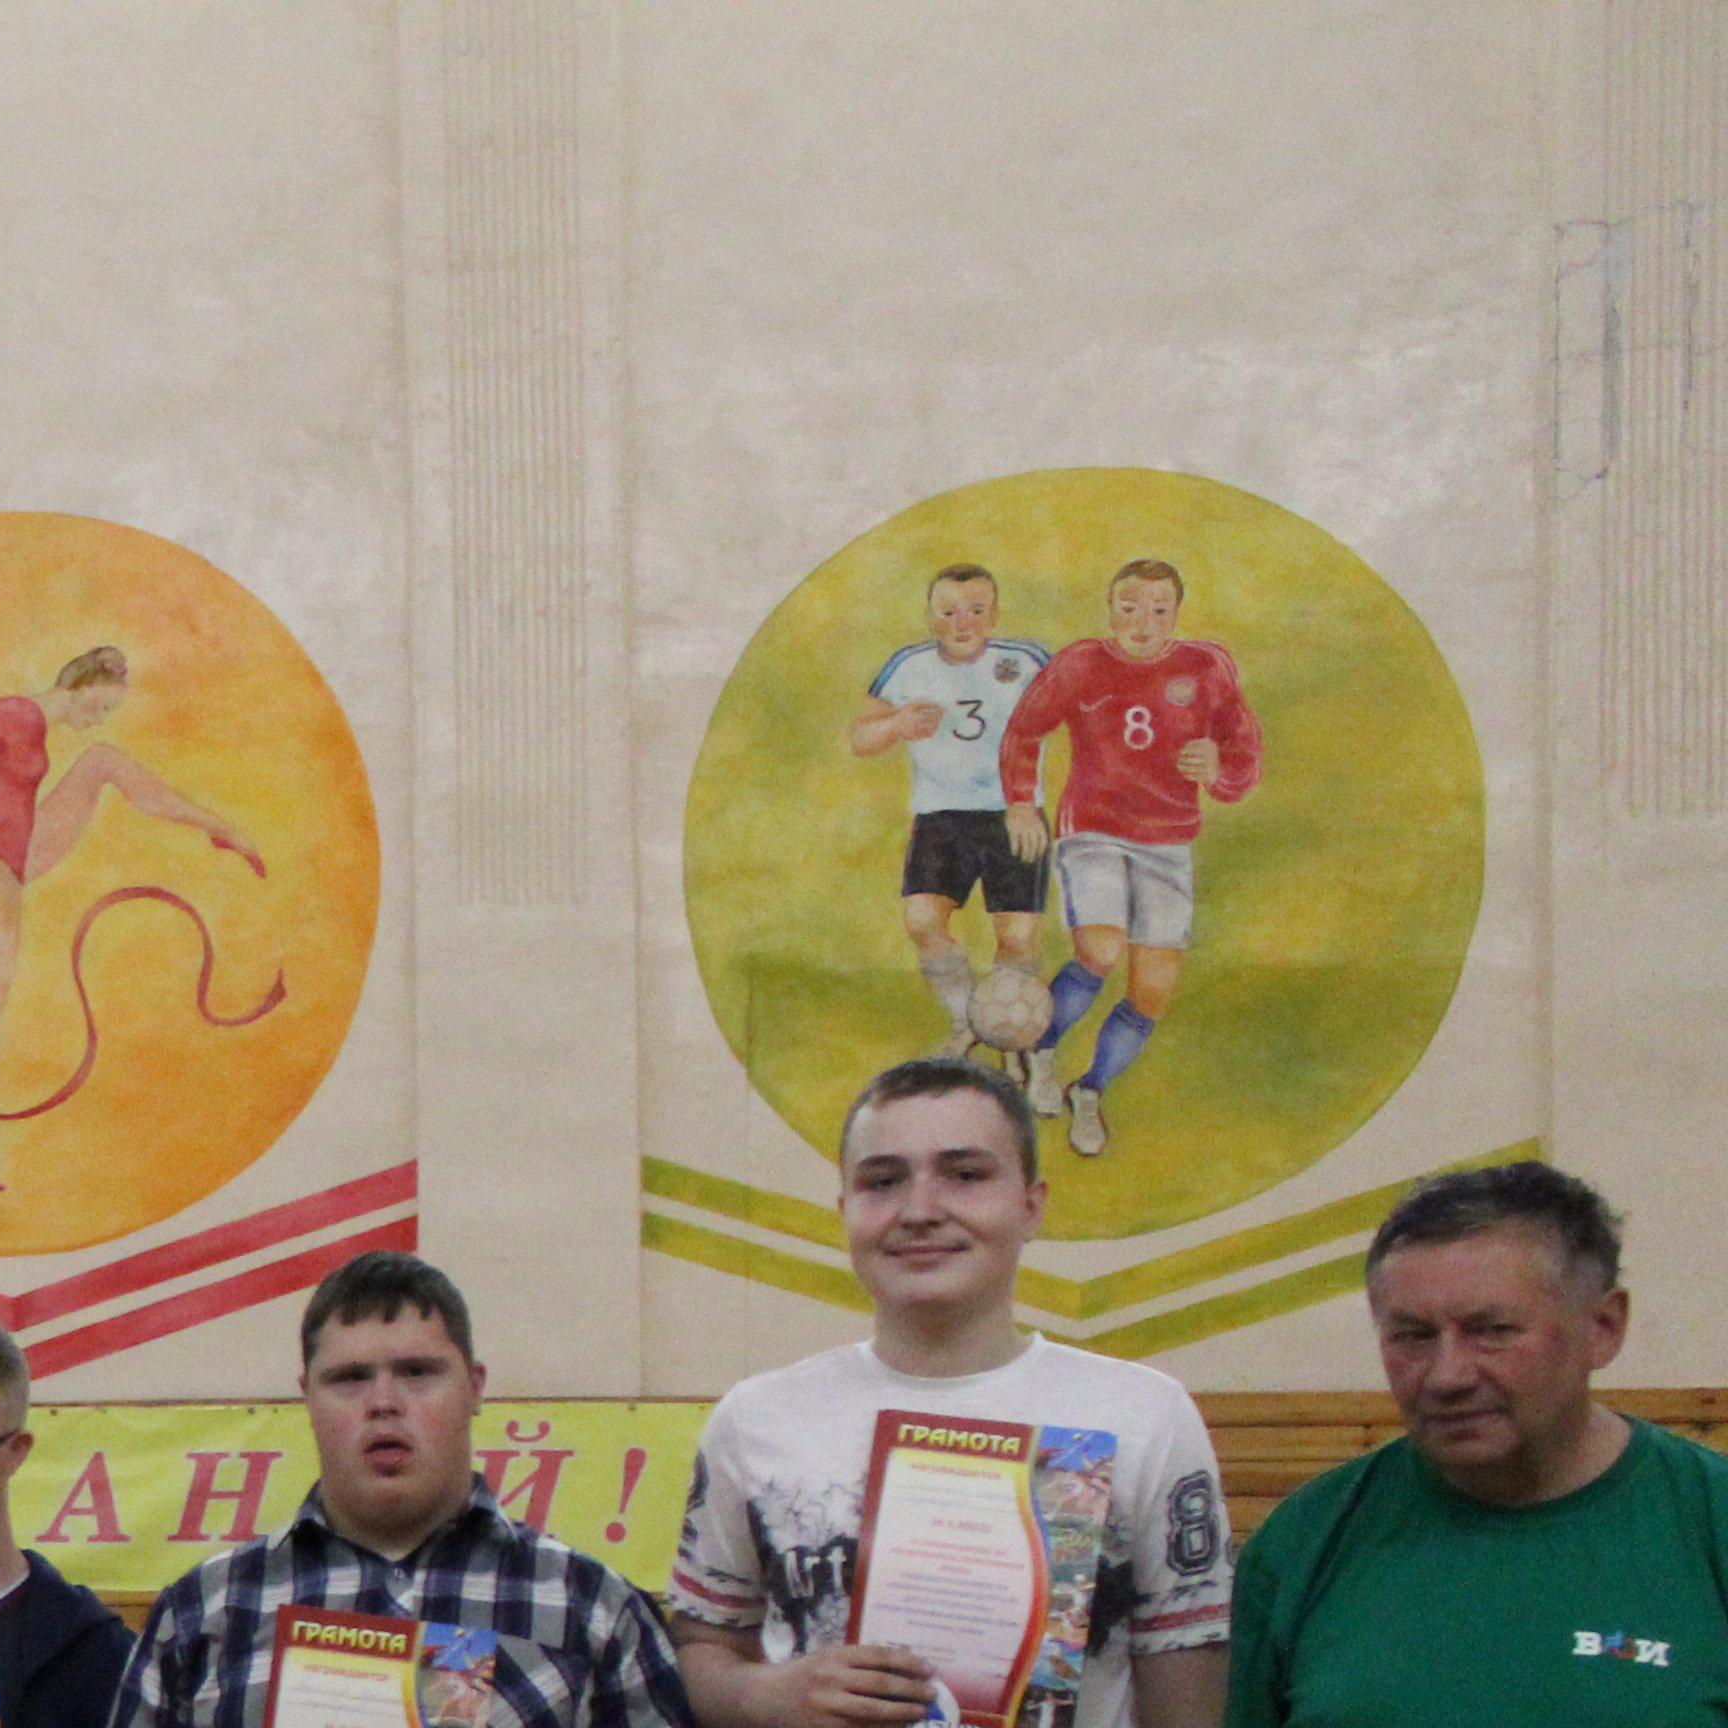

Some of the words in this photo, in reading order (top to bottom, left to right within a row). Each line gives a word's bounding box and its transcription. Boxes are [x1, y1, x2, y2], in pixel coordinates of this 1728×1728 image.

[952, 700, 986, 741] 3
[1123, 706, 1155, 750] 8
[898, 1423, 1021, 1455] ГРАМОТА
[292, 1620, 407, 1653] ГРАМОТА
